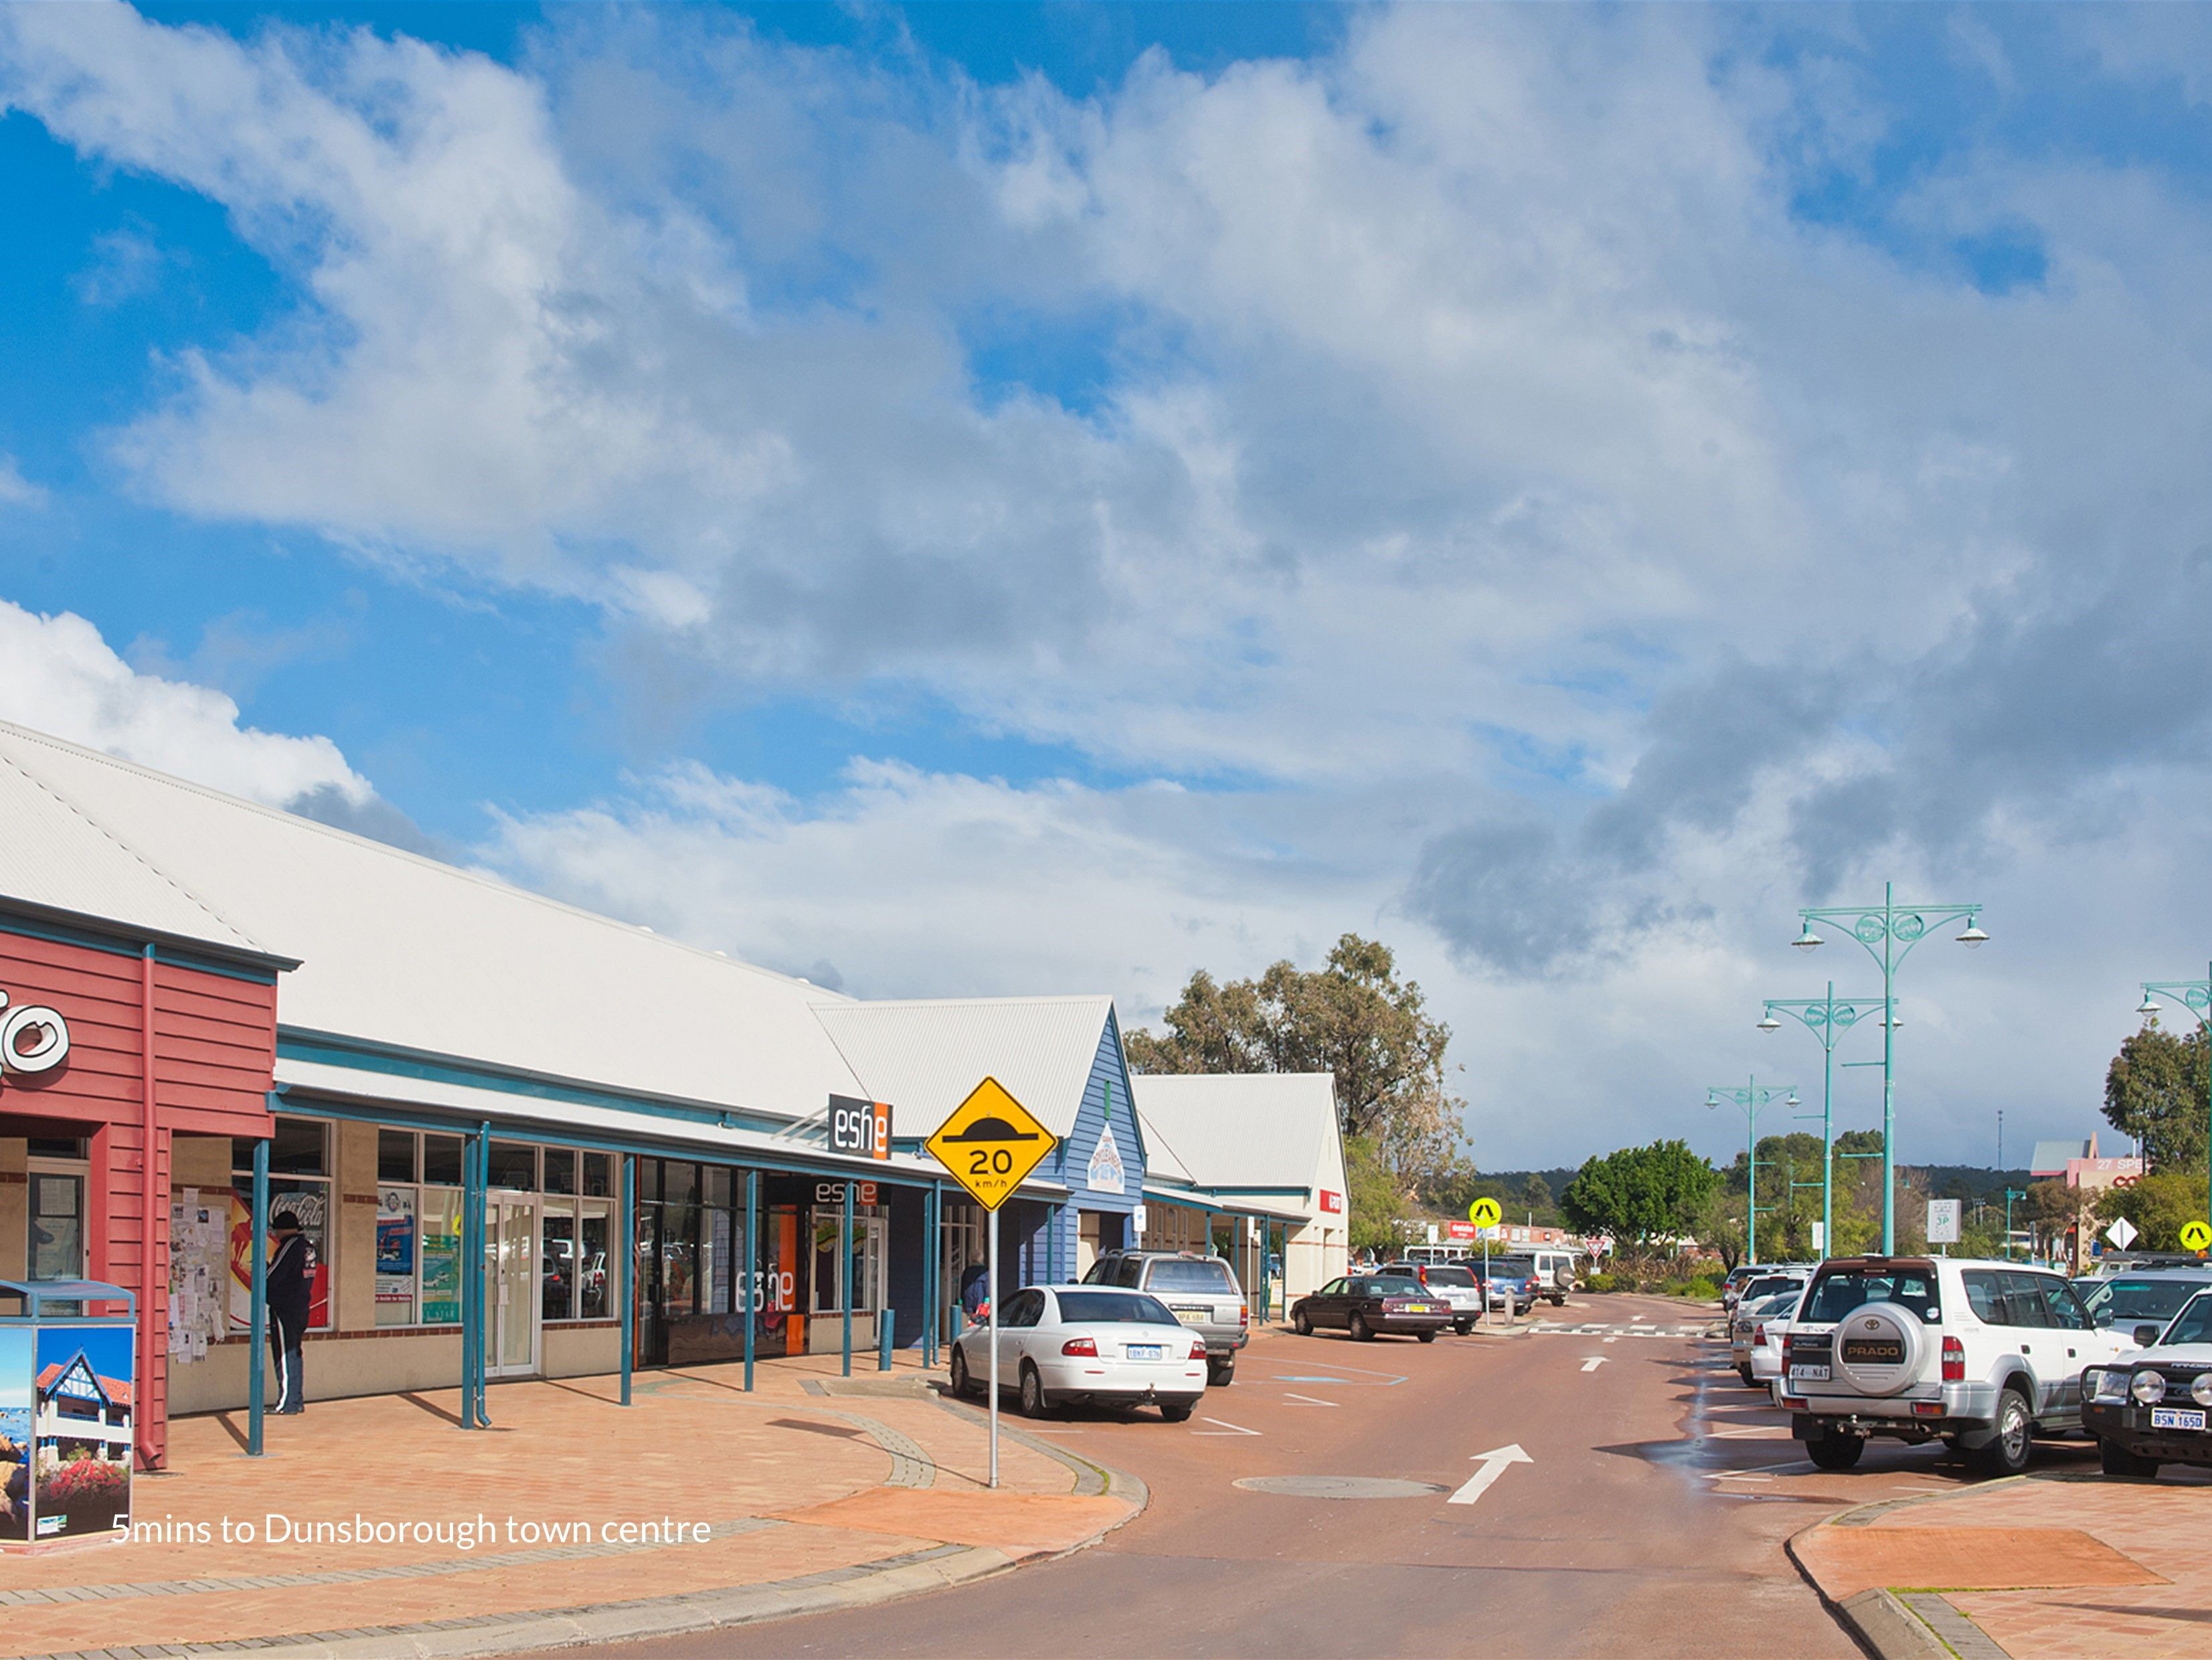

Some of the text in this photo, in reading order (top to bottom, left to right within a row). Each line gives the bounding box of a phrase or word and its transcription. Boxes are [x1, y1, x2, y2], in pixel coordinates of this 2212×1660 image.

[835, 1105, 887, 1152] eshe
[969, 1149, 1013, 1175] 20
[2098, 1159, 2112, 1170] 27
[975, 1179, 1007, 1188] km/h
[1847, 1346, 1899, 1357] PRADO
[2154, 1414, 2175, 1426] BSN
